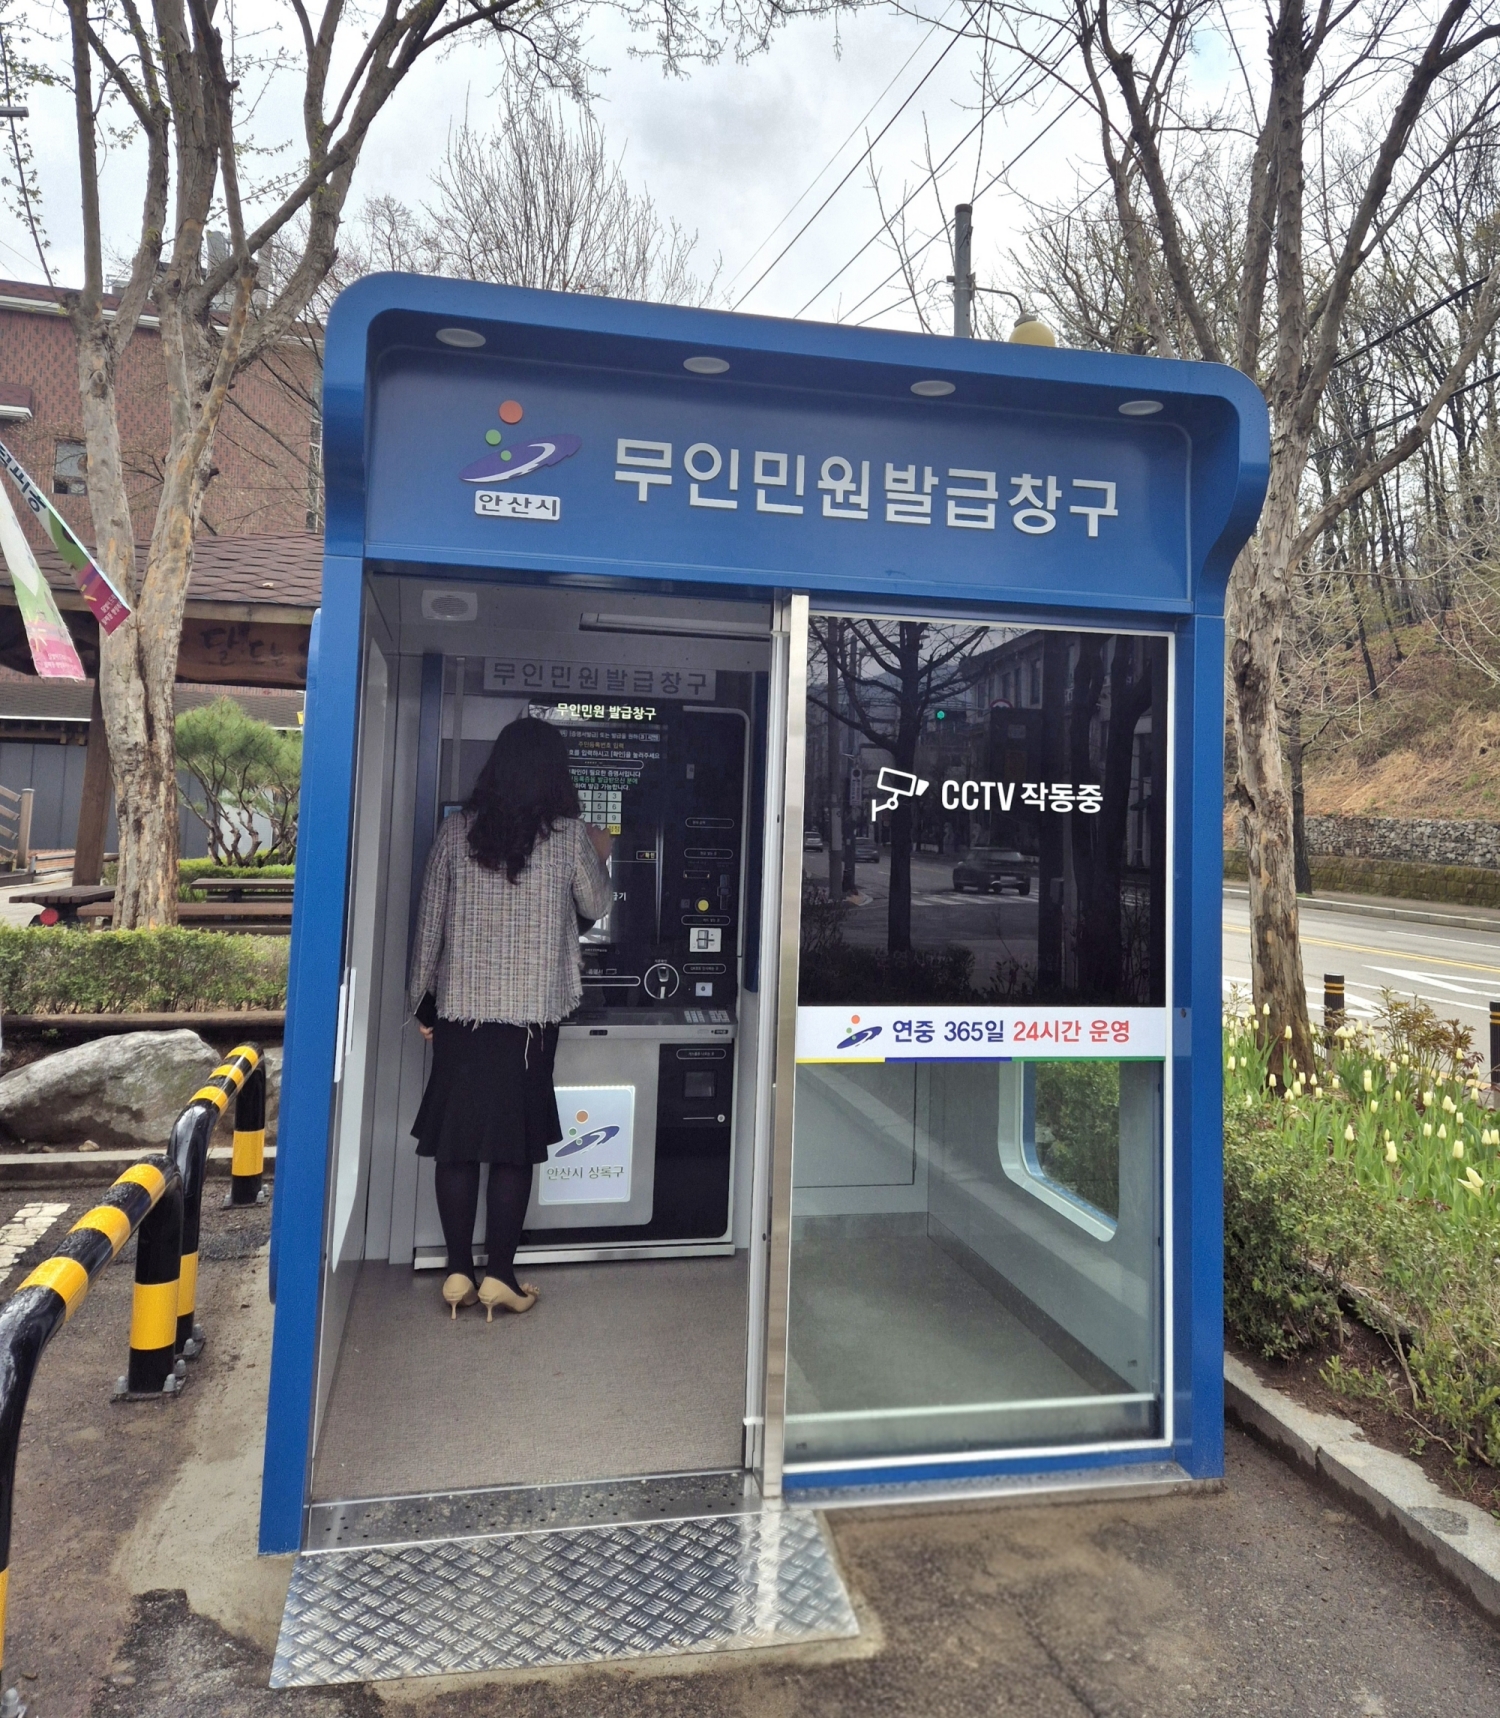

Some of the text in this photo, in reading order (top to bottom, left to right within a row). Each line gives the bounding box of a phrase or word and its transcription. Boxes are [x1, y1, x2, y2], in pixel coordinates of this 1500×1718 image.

[614, 437, 1119, 538] 무인민원발급창구
[478, 493, 557, 518] 안산시
[493, 662, 708, 696] 무인민원발급창구
[556, 702, 657, 720] 무인민원 발급창구
[569, 768, 588, 776] 확인이
[941, 779, 1104, 814] CCTV 작동중
[892, 1019, 1131, 1043] 연중 365일 24시간 운영
[546, 1164, 625, 1181] 안산시 상록구
